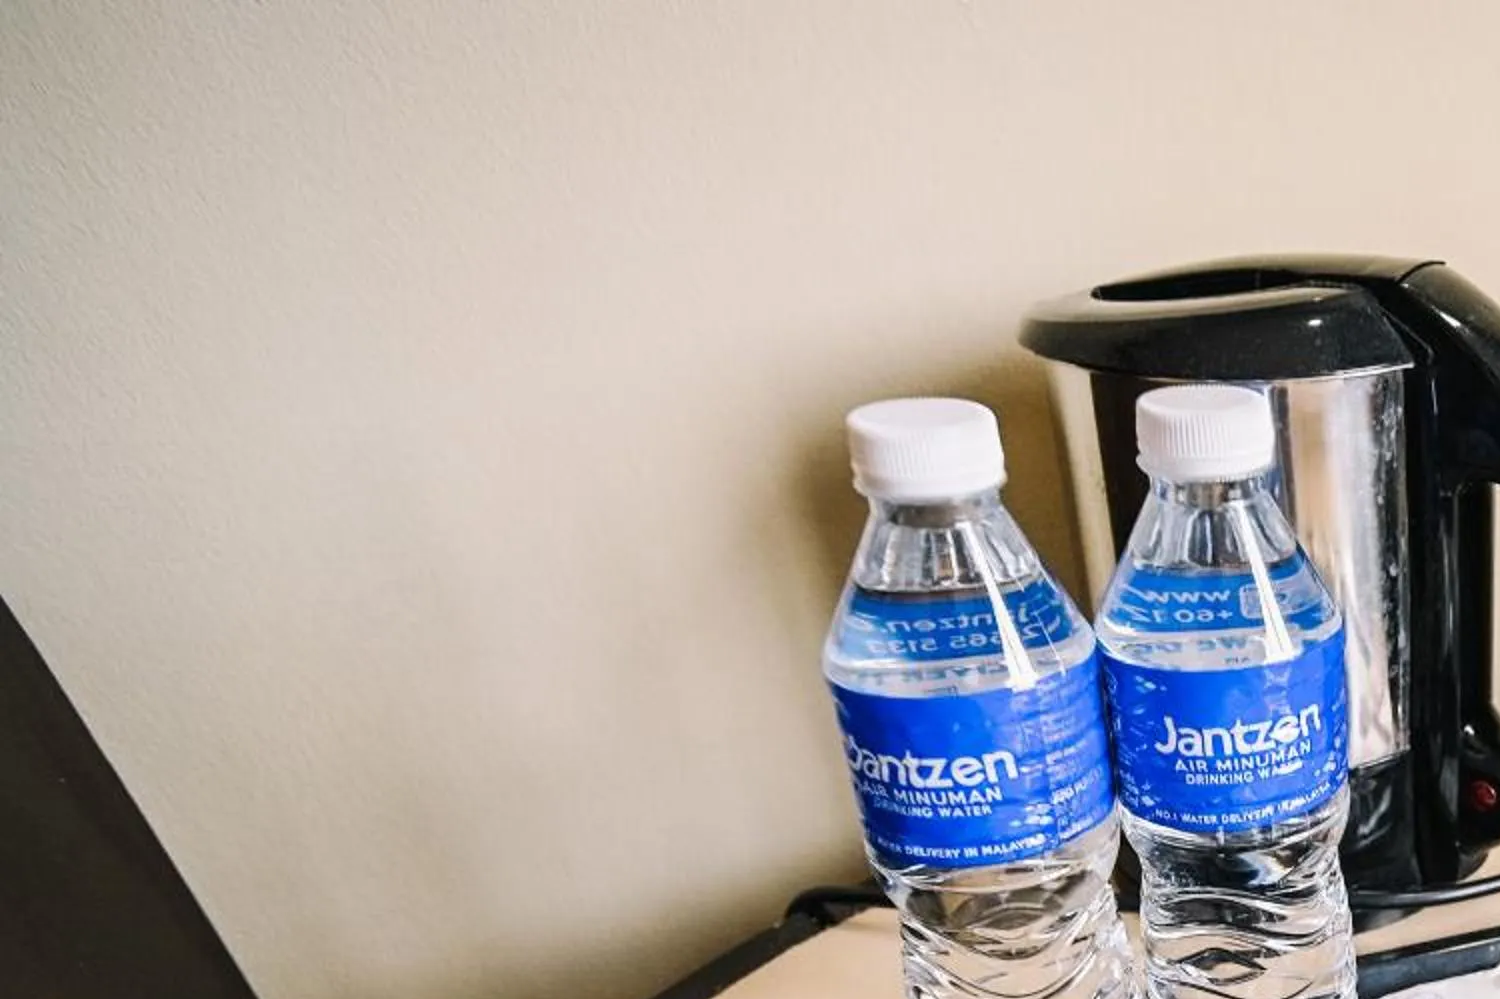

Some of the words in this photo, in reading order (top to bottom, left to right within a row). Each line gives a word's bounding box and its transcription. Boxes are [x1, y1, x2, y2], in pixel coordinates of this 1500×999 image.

[1155, 703, 1321, 757] Jantzen
[849, 735, 1019, 789] Jantzen
[1175, 759, 1208, 773] AIR
[1217, 739, 1311, 772] MINUMAN
[1186, 771, 1254, 785] DRINKING
[893, 786, 1003, 807] MINUMAN
[938, 804, 993, 818] WATER
[1181, 813, 1217, 826] WATER
